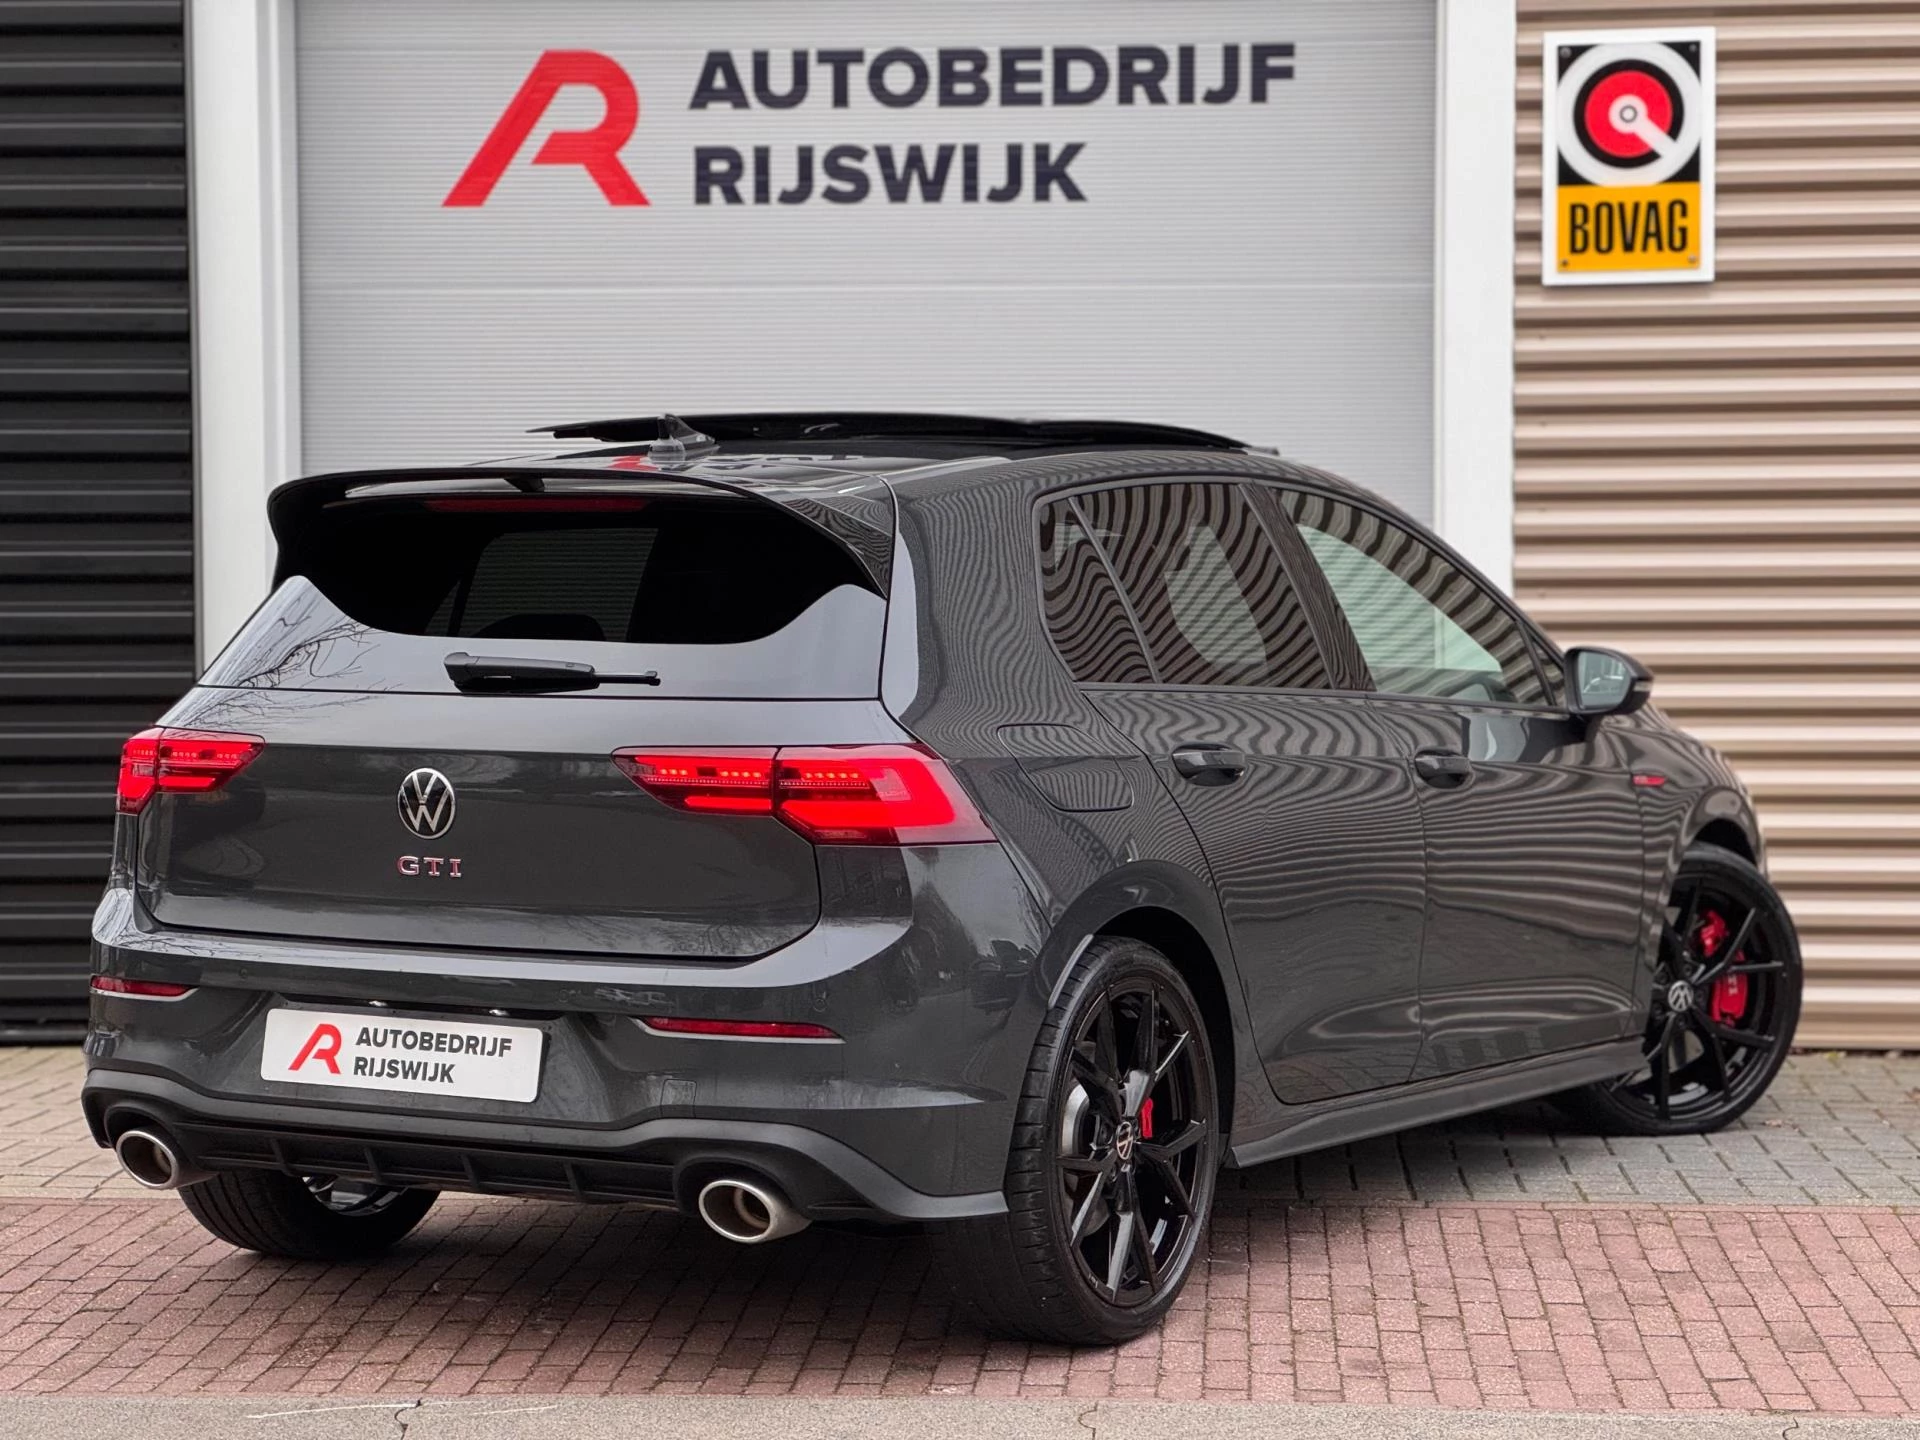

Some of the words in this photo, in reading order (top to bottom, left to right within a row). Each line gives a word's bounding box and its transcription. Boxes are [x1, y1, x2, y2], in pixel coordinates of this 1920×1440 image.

[689, 43, 1296, 110] AUTOBEDRIJF
[694, 142, 1088, 206] RIJSWIJK
[1569, 199, 1689, 255] BOVAG
[397, 855, 462, 877] GTI
[354, 1026, 513, 1058] AUTOBEDRIJF
[353, 1056, 456, 1083] RIJSWIJK
